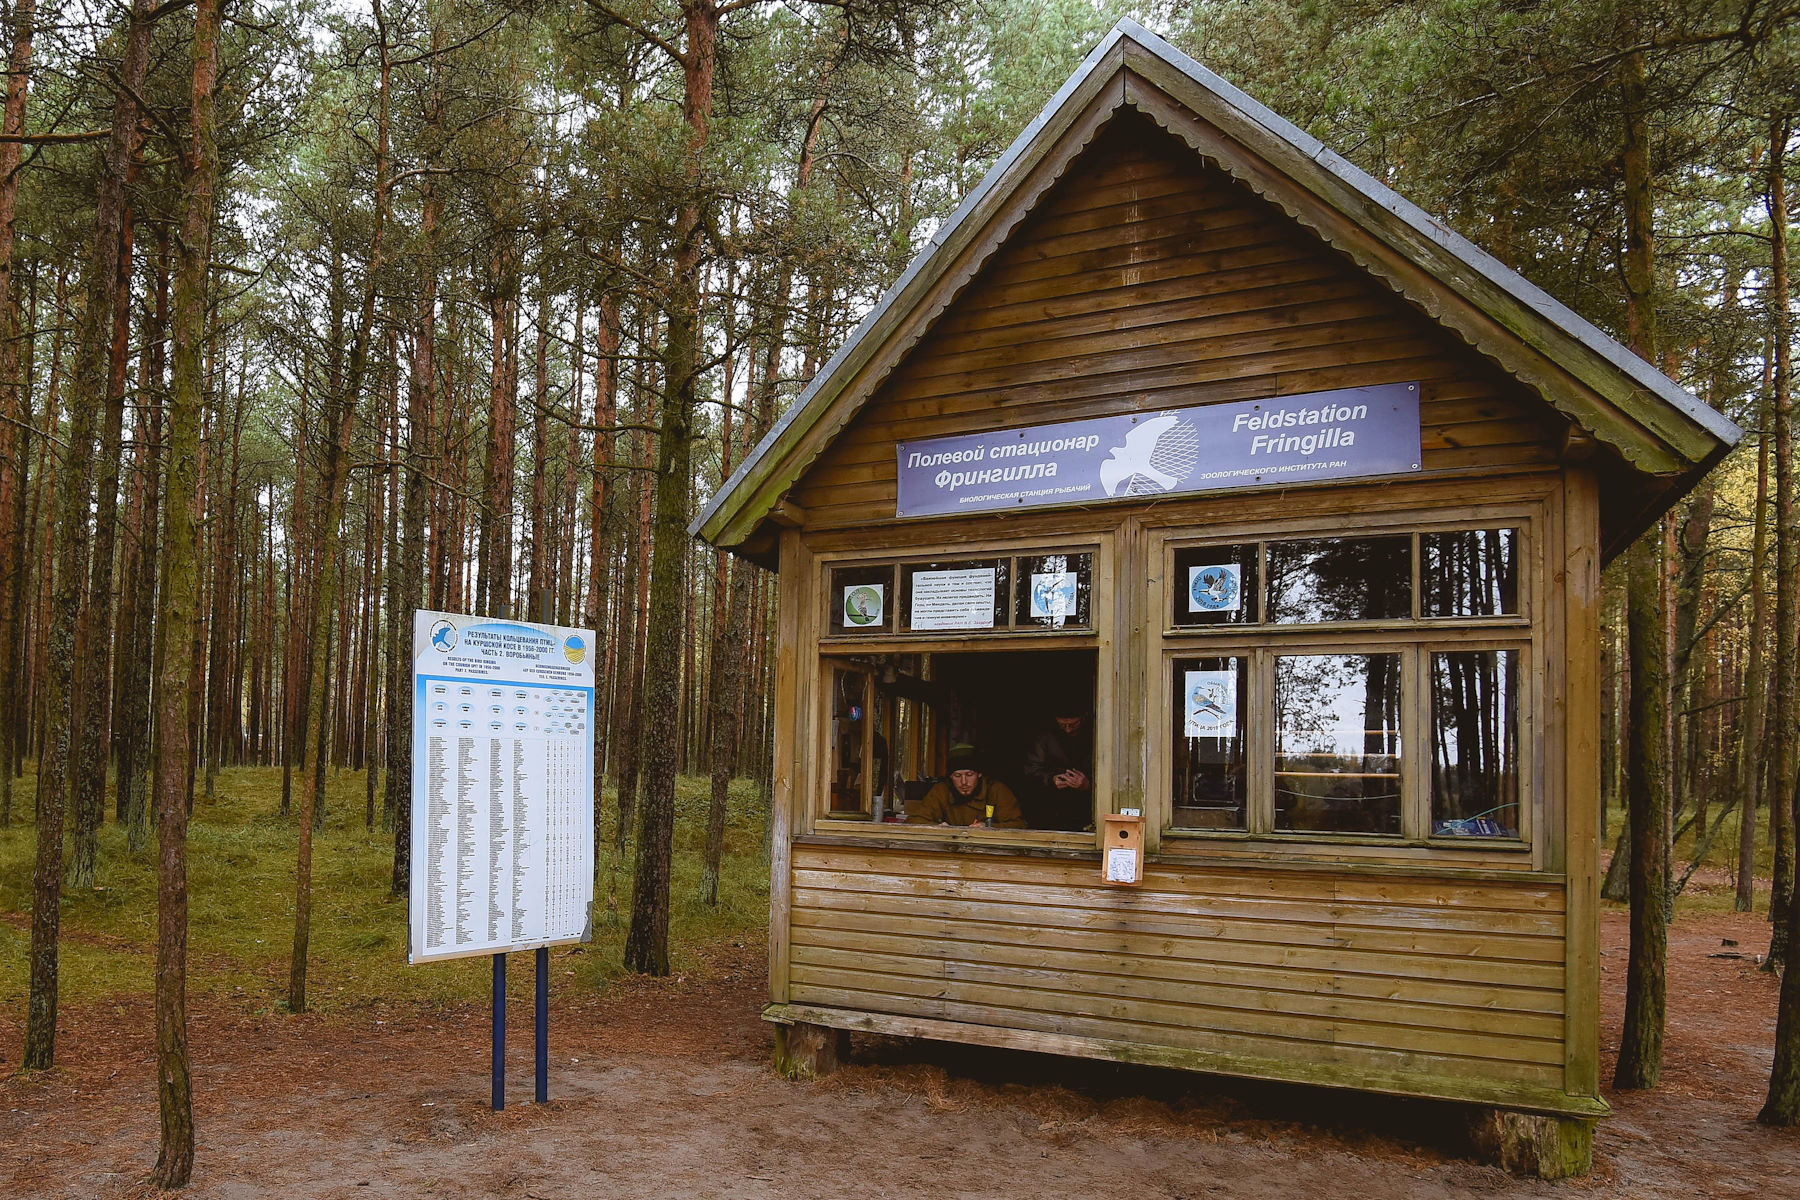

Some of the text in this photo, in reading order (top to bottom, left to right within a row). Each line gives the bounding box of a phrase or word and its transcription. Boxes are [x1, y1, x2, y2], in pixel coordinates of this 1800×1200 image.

[1233, 404, 1368, 432] Feldstation
[907, 435, 1099, 469] Полевой стационар
[1250, 428, 1355, 456] Fringilla
[935, 462, 1058, 491] Фрингилла
[1201, 460, 1347, 480] ЗООЛОГИЧЕСКОГО ИНСТИТУТА РАН
[960, 483, 1091, 503] БИОЛОГИЧЕСКАЯ СТАНЦИЯ РЫБАЧИЙ
[468, 631, 502, 640] РЕЗУЛЬТАТЫ
[473, 640, 502, 649] КУРШСКОЙ
[506, 652, 540, 660] ВОРОБЬИНЫЕ
